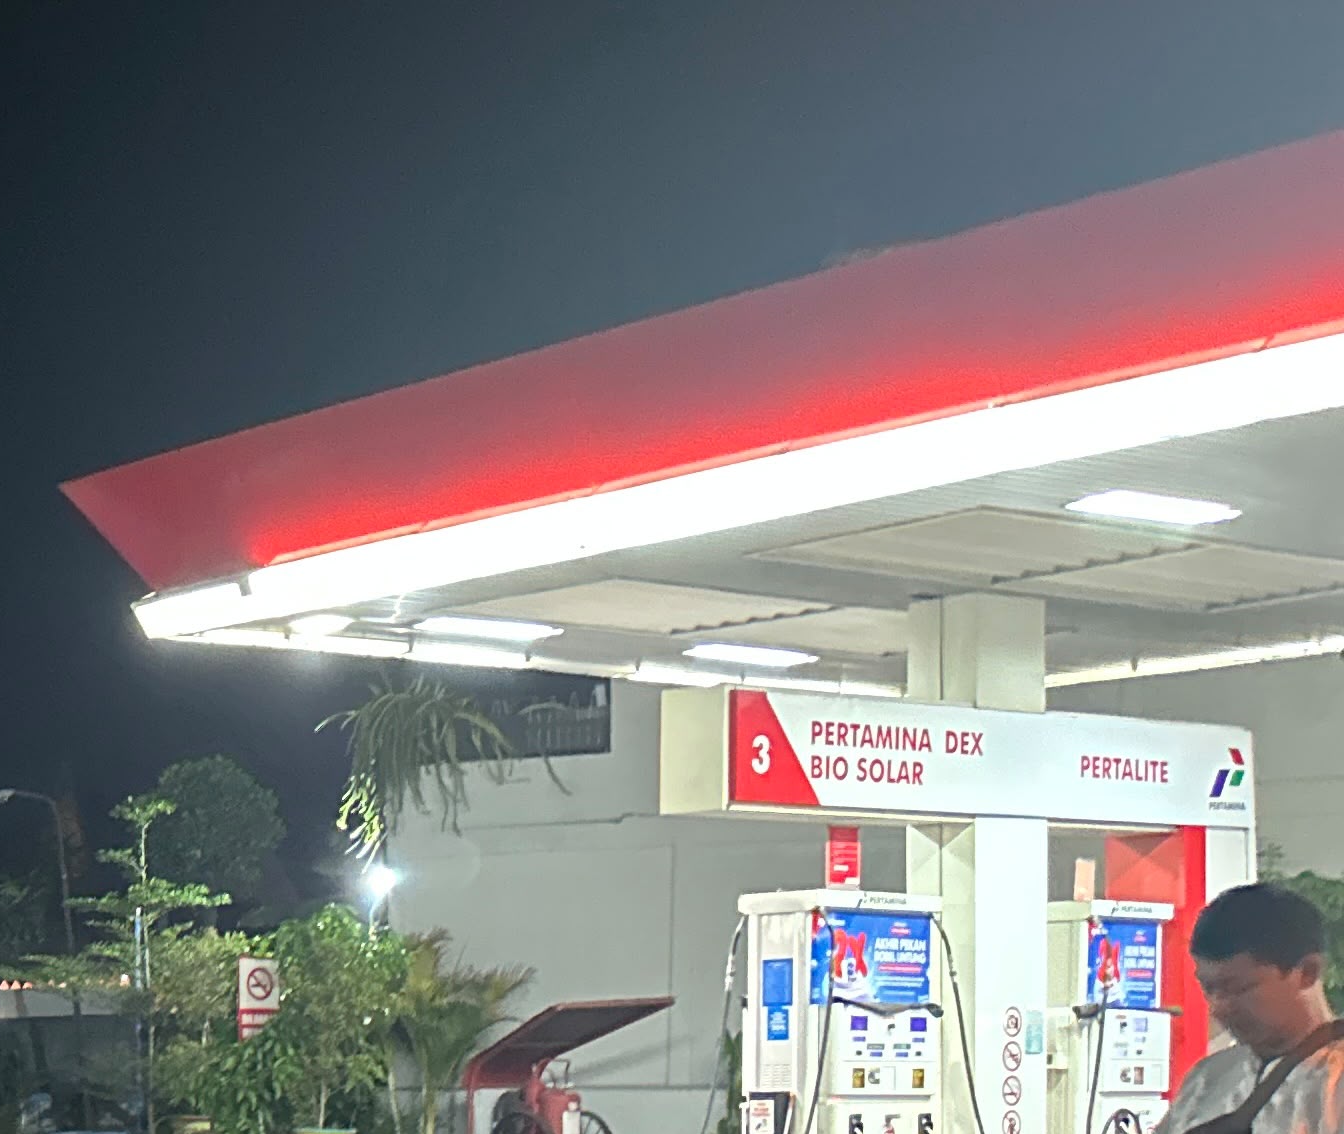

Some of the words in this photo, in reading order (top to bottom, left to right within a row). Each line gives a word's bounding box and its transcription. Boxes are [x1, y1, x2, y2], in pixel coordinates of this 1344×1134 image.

[751, 734, 771, 775] 3
[811, 720, 933, 753] PERTAMINA
[944, 730, 985, 756] DEX
[810, 755, 849, 781] BIO
[856, 757, 924, 786] SOLAR
[1080, 754, 1169, 784] PERTALITE
